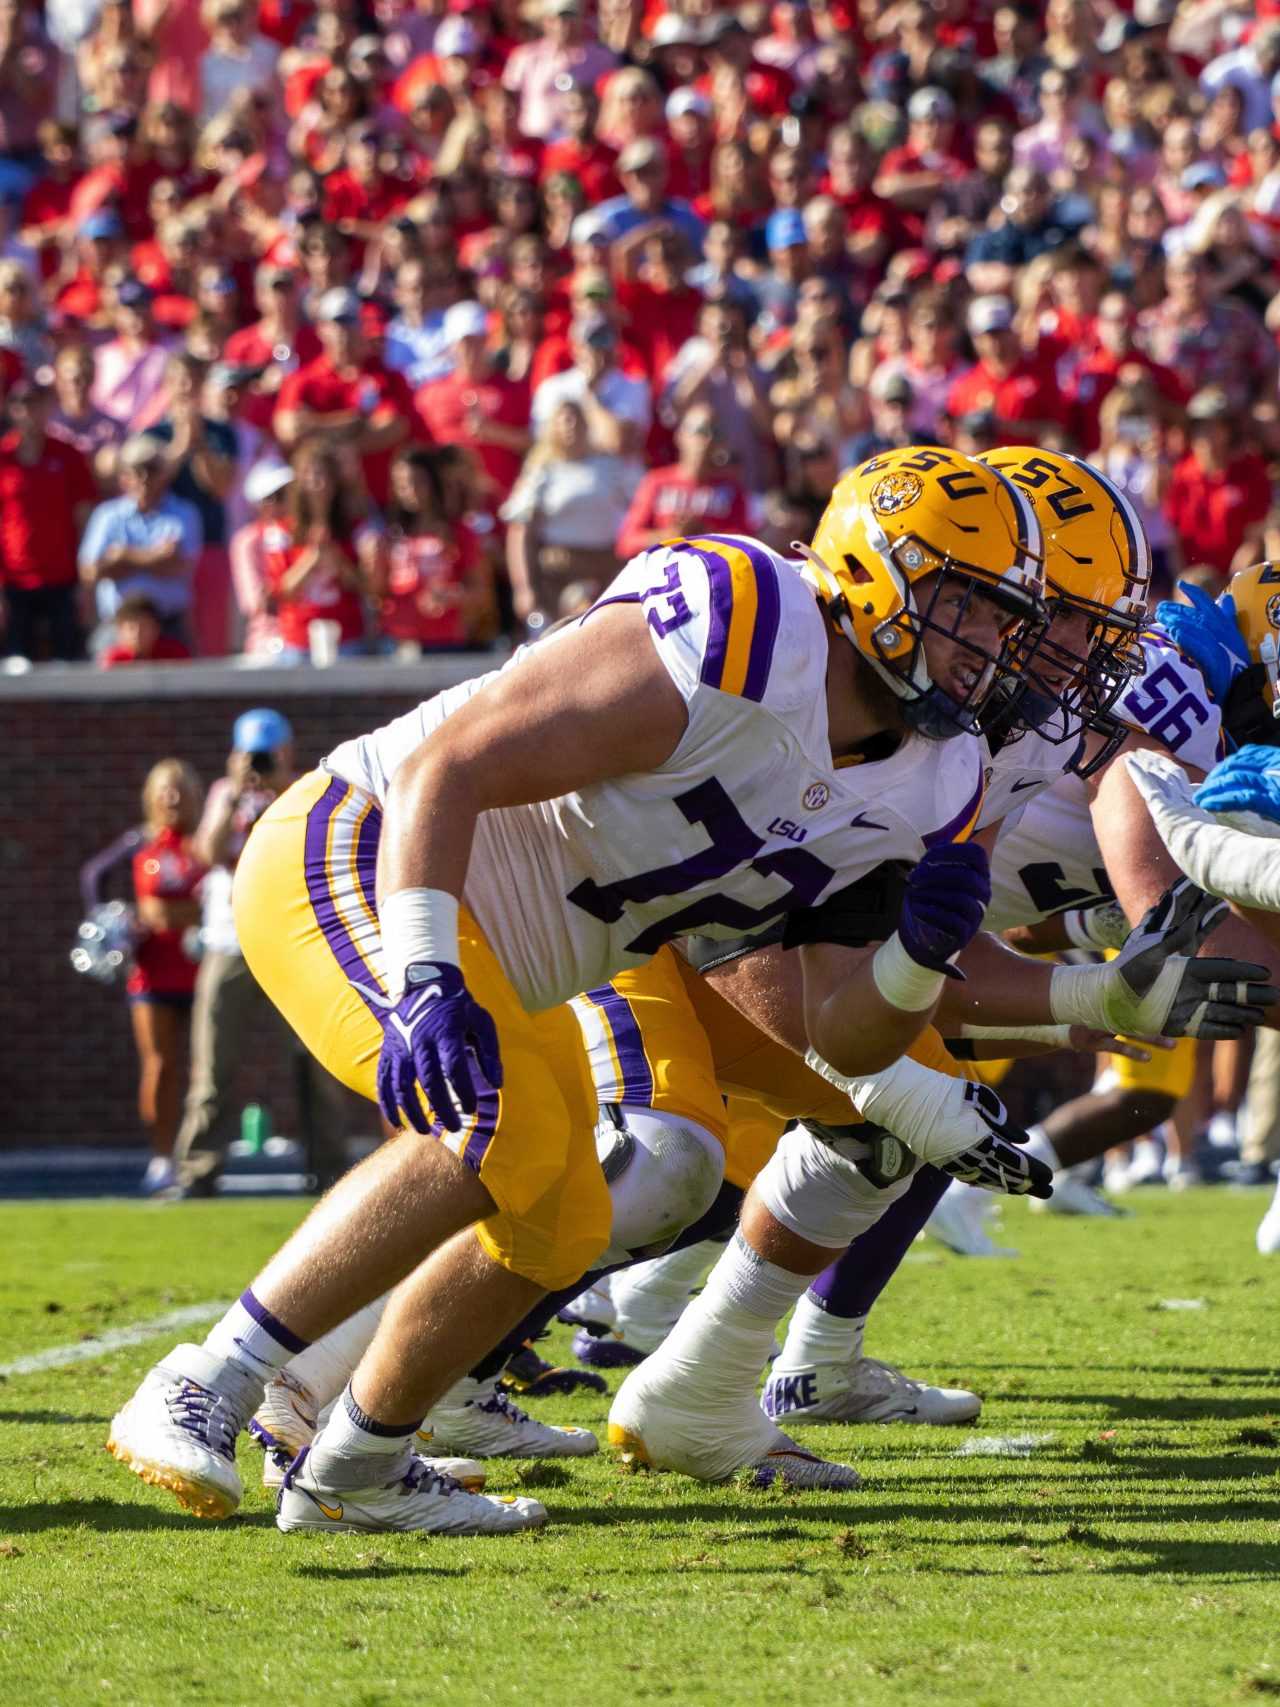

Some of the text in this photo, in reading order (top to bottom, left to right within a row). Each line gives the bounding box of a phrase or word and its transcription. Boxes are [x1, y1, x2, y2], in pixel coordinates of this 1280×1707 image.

[1009, 457, 1096, 520] SU
[1123, 661, 1210, 753] 56
[566, 775, 837, 956] 72
[766, 816, 808, 843] LSU
